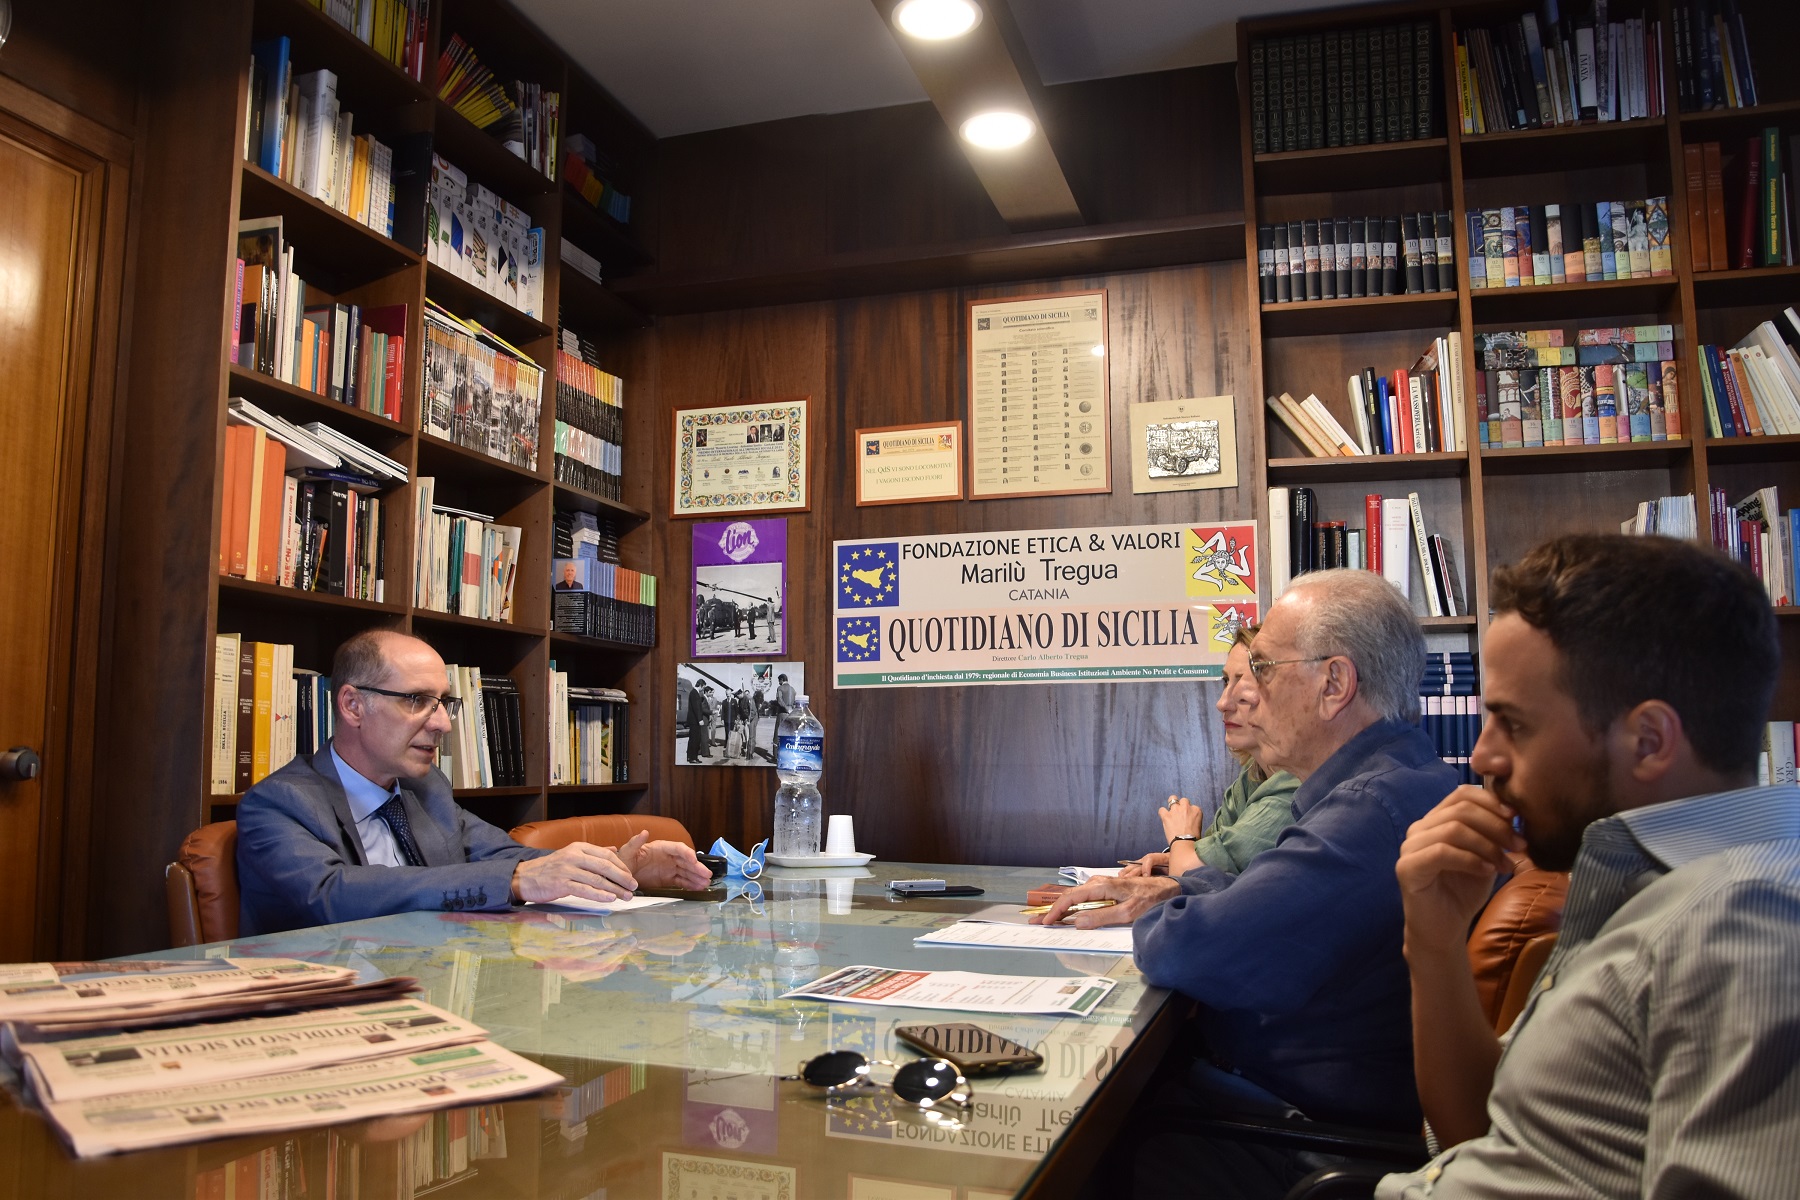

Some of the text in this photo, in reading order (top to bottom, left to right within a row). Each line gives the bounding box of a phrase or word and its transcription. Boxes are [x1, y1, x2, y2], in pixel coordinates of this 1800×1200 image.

[1579, 58, 1589, 81] MAYA
[1002, 314, 1040, 324] QUOTIDIANO
[1048, 311, 1070, 319] SICILIA
[1412, 386, 1417, 394] LA
[882, 439, 911, 449] QUOTIDIANO
[918, 436, 935, 445] SICILIA
[877, 465, 891, 475] QdS
[915, 462, 952, 471] LOCOMOTIVE
[901, 475, 924, 483] ESCONO
[925, 474, 943, 482] FUORI
[902, 531, 1180, 560] FONDAZIONE ETICA & VALORI
[961, 558, 1118, 586] Marilù Tregua
[1008, 588, 1070, 601] CATANIA
[888, 609, 1199, 662] QUOTIDIANO DI SICILIA
[1038, 653, 1063, 661] Alberto
[1065, 653, 1089, 661] Tregua
[887, 674, 920, 683] Quotidiano
[921, 673, 953, 681] d'inchiesta
[965, 672, 981, 680] 1979:
[982, 672, 1010, 681] regionale
[1019, 670, 1049, 678] Economia
[1078, 669, 1109, 677] Istituzioni
[1110, 668, 1141, 676] Ambiente
[1142, 668, 1152, 676] No
[1153, 667, 1171, 675] Profit
[1178, 667, 1209, 675] Consumo
[1776, 766, 1784, 783] MA
[1785, 761, 1793, 783] GRA
[144, 1023, 389, 1058] QUOTIDIANO DI SICILIA
[305, 1073, 446, 1106] QUOTIDIANO
[272, 1092, 297, 1107] DI
